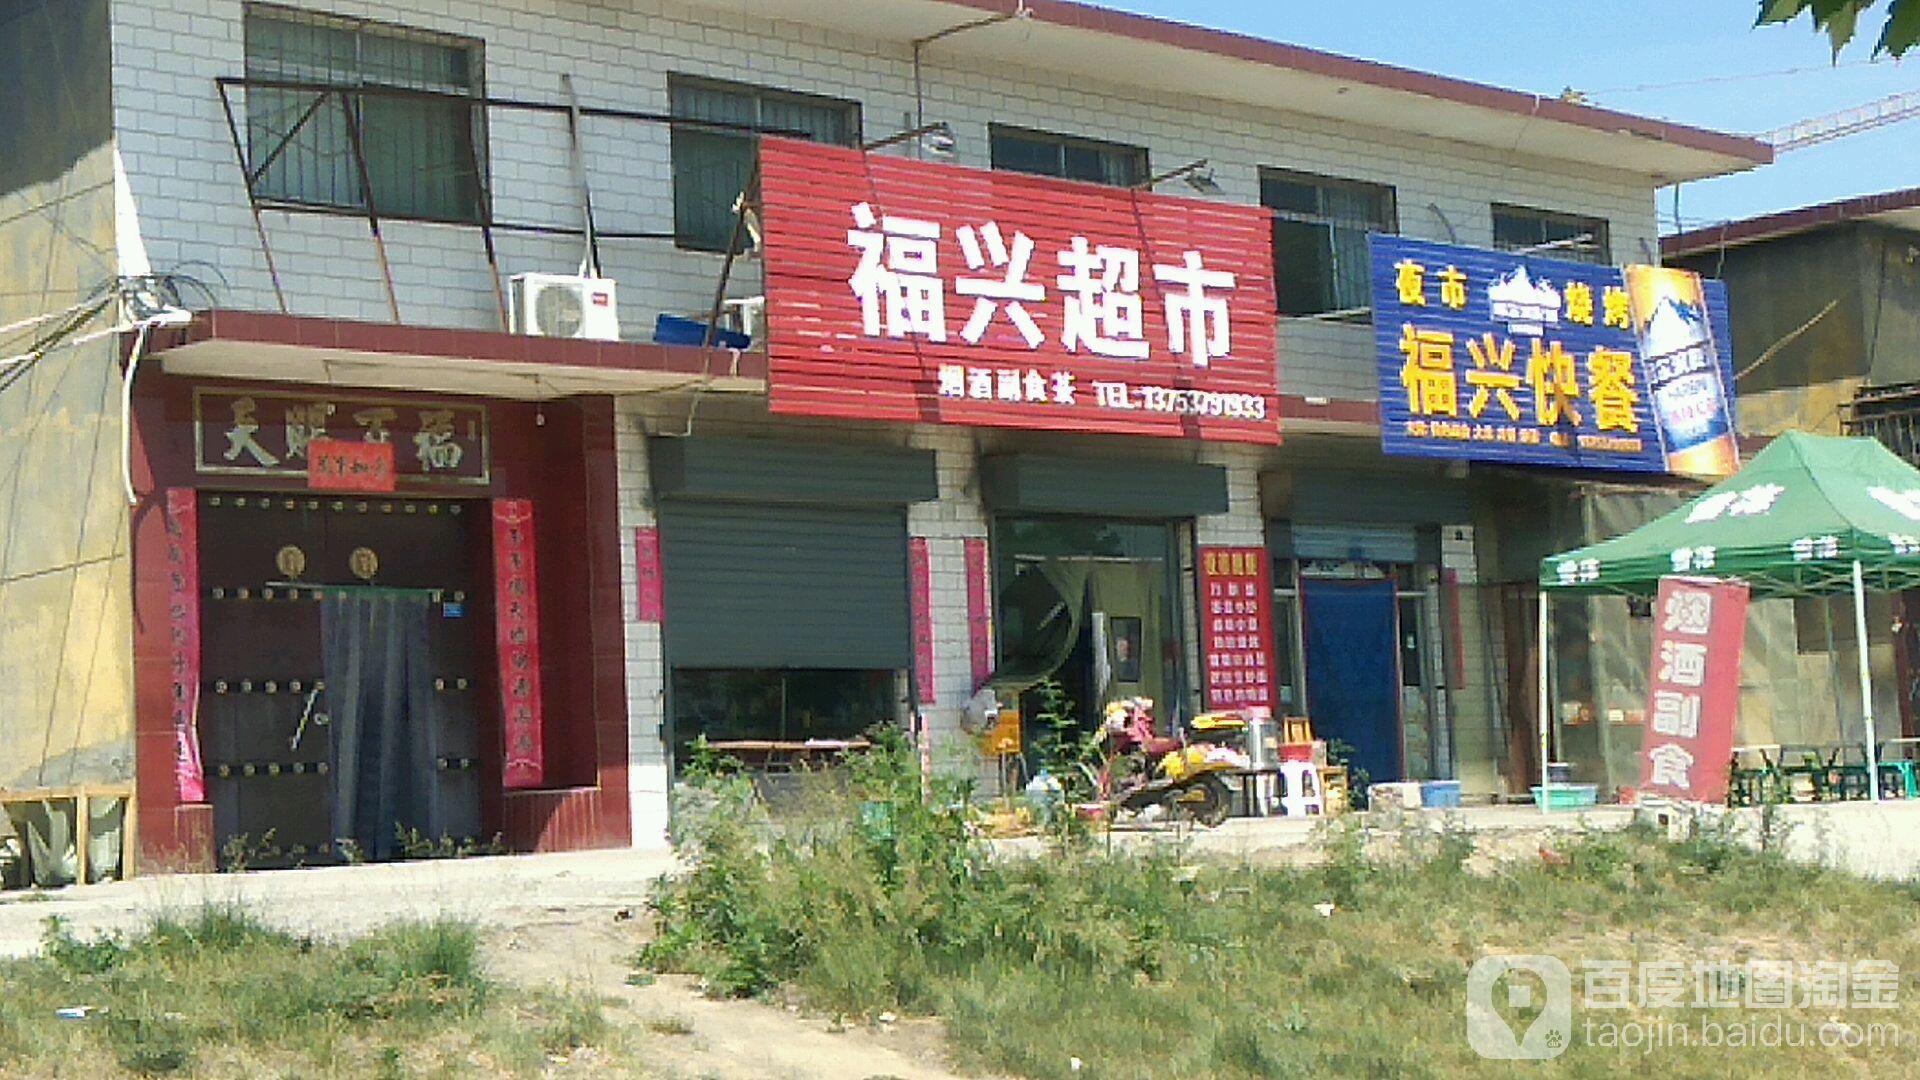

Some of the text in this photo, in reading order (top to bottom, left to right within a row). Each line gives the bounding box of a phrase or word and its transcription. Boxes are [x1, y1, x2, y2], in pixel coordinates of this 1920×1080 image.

[847, 202, 1235, 368] 福兴超市
[1394, 258, 1468, 310] 夜市
[1399, 322, 1638, 433] 福兴快餐
[1650, 590, 1711, 788] 烟酒副食
